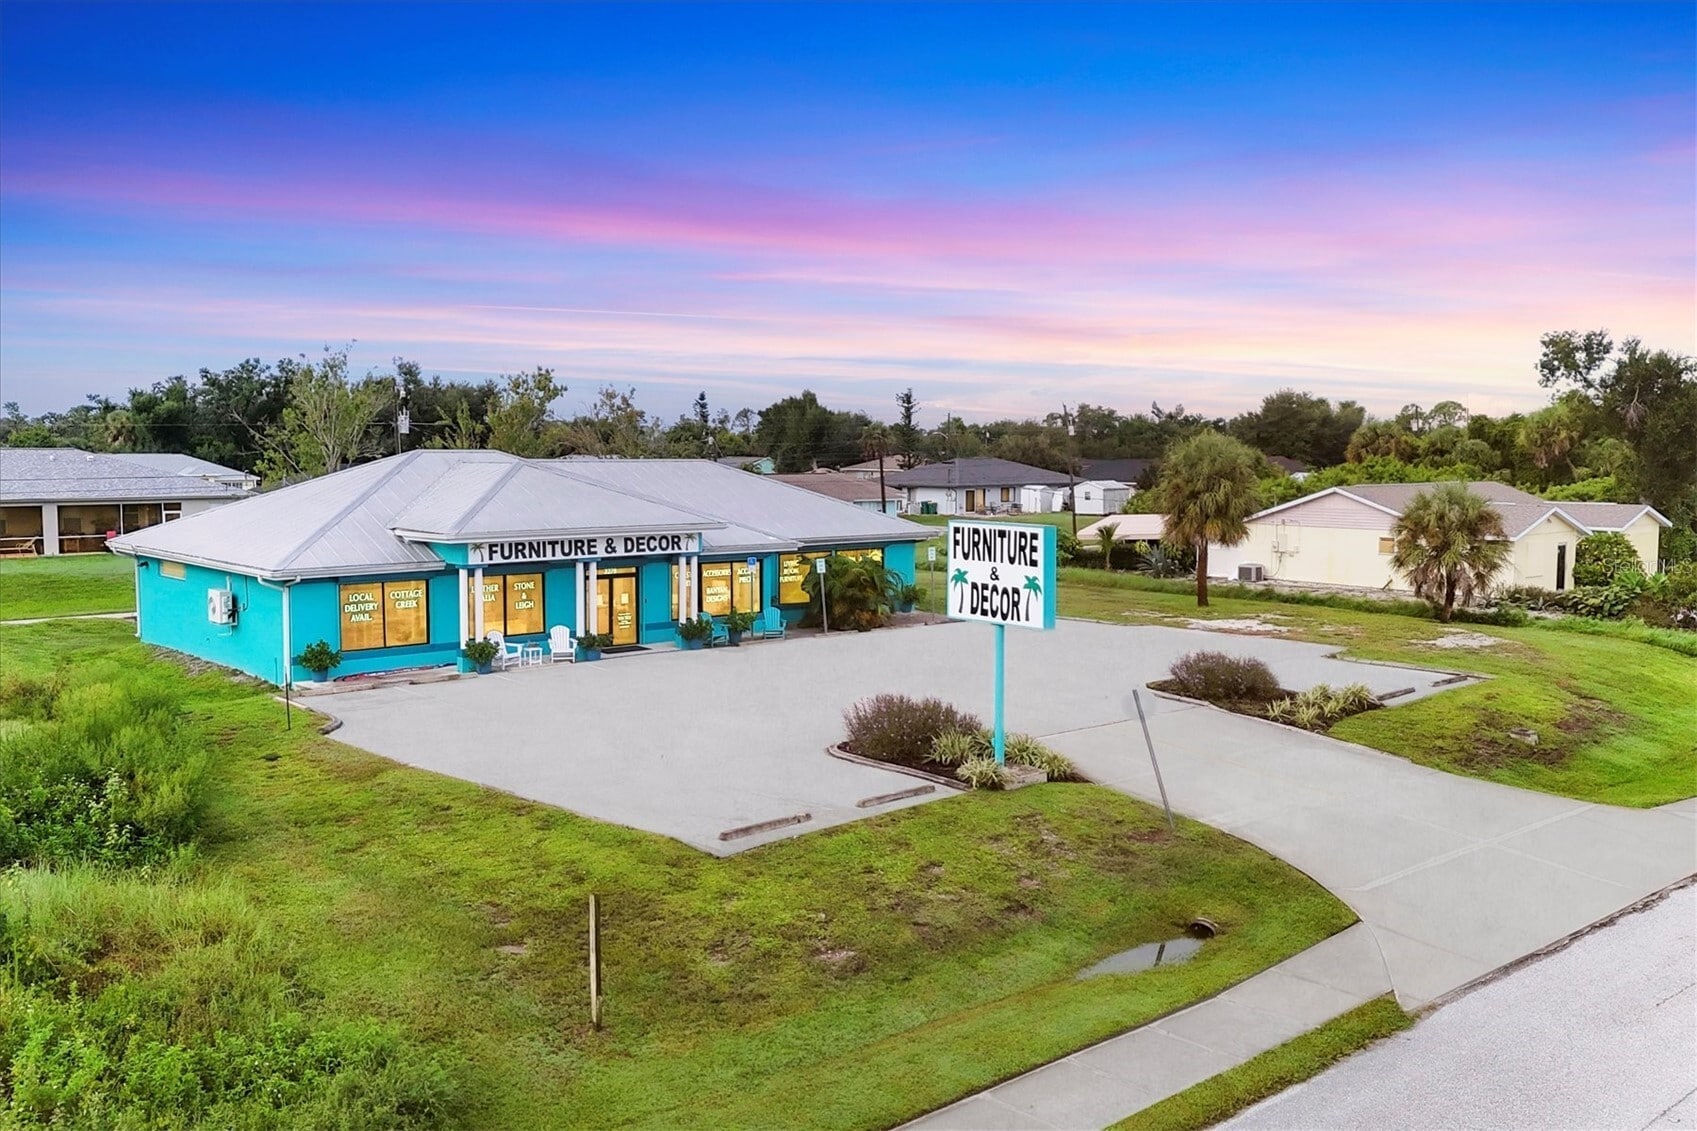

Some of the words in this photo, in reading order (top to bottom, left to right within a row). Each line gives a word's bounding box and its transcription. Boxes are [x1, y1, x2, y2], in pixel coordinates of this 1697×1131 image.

[488, 539, 598, 561] FURNITURE
[604, 537, 617, 554] &
[623, 534, 682, 553] DECOR
[953, 526, 1039, 567] FURNITURE
[990, 566, 1000, 581] &
[471, 584, 499, 593] LTHER
[513, 581, 535, 591] STONE
[348, 593, 374, 602] LOCAL
[389, 589, 423, 600] COTTAGE
[395, 599, 418, 609] CREEK
[515, 601, 534, 610] LEIGH
[970, 582, 1021, 622] DECOR
[344, 602, 378, 613] DELIVERY
[350, 613, 373, 622] AVAIL.
